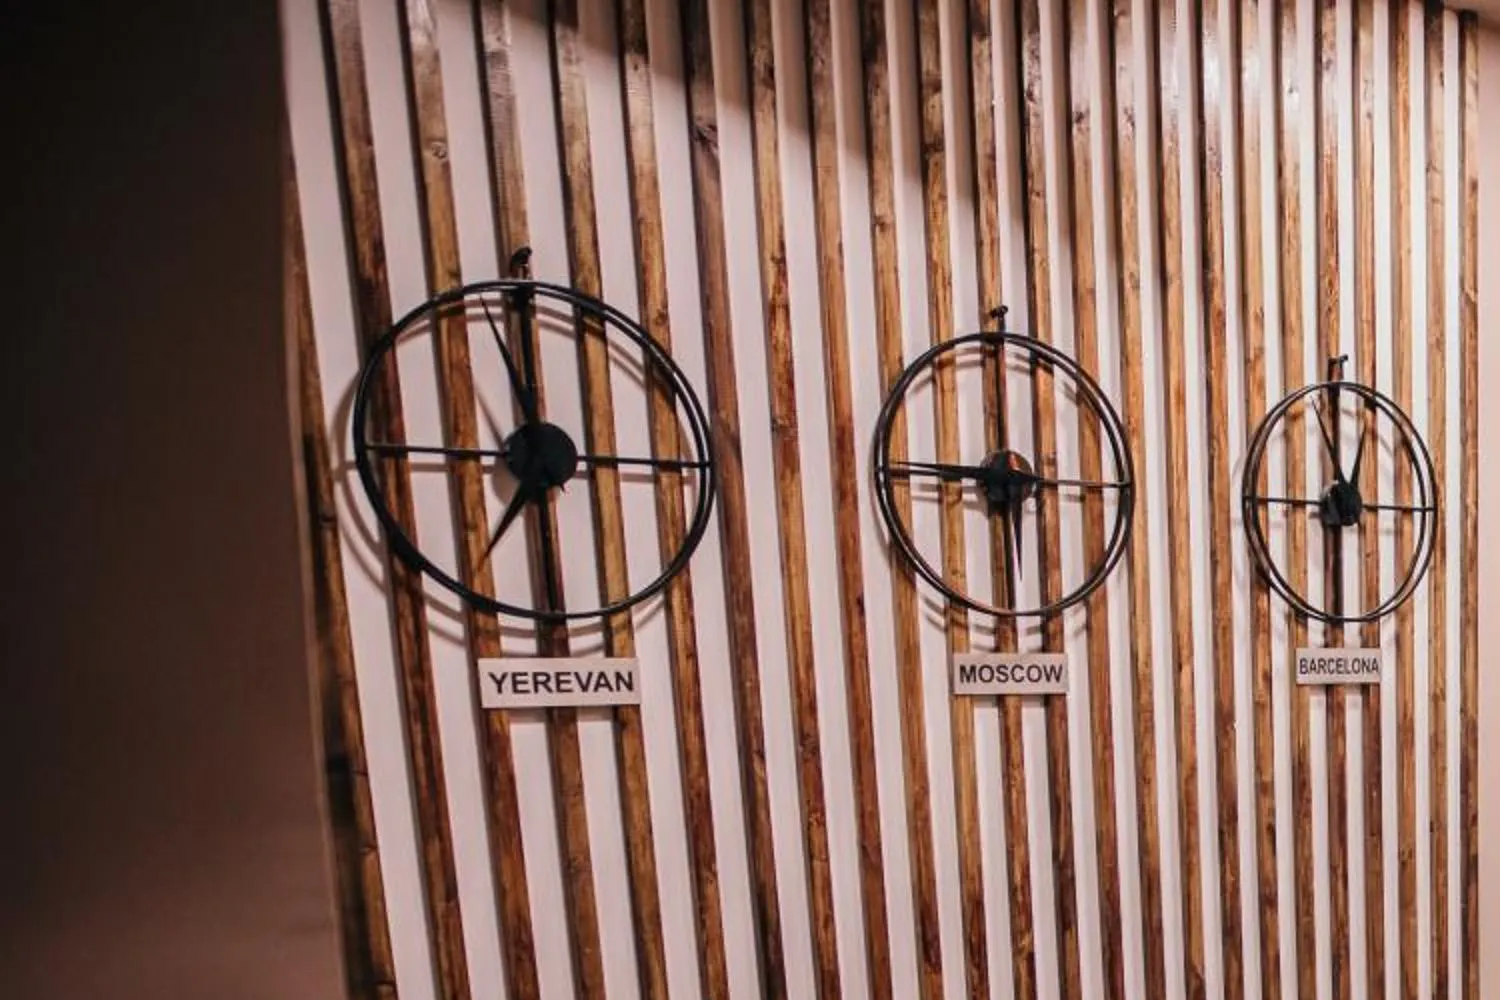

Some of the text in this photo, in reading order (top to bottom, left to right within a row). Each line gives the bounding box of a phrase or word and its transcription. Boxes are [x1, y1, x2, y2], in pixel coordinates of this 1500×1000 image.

[959, 664, 1063, 683] MOSCOW
[1299, 657, 1379, 675] BARCELONA
[488, 671, 634, 694] YEREVAN
